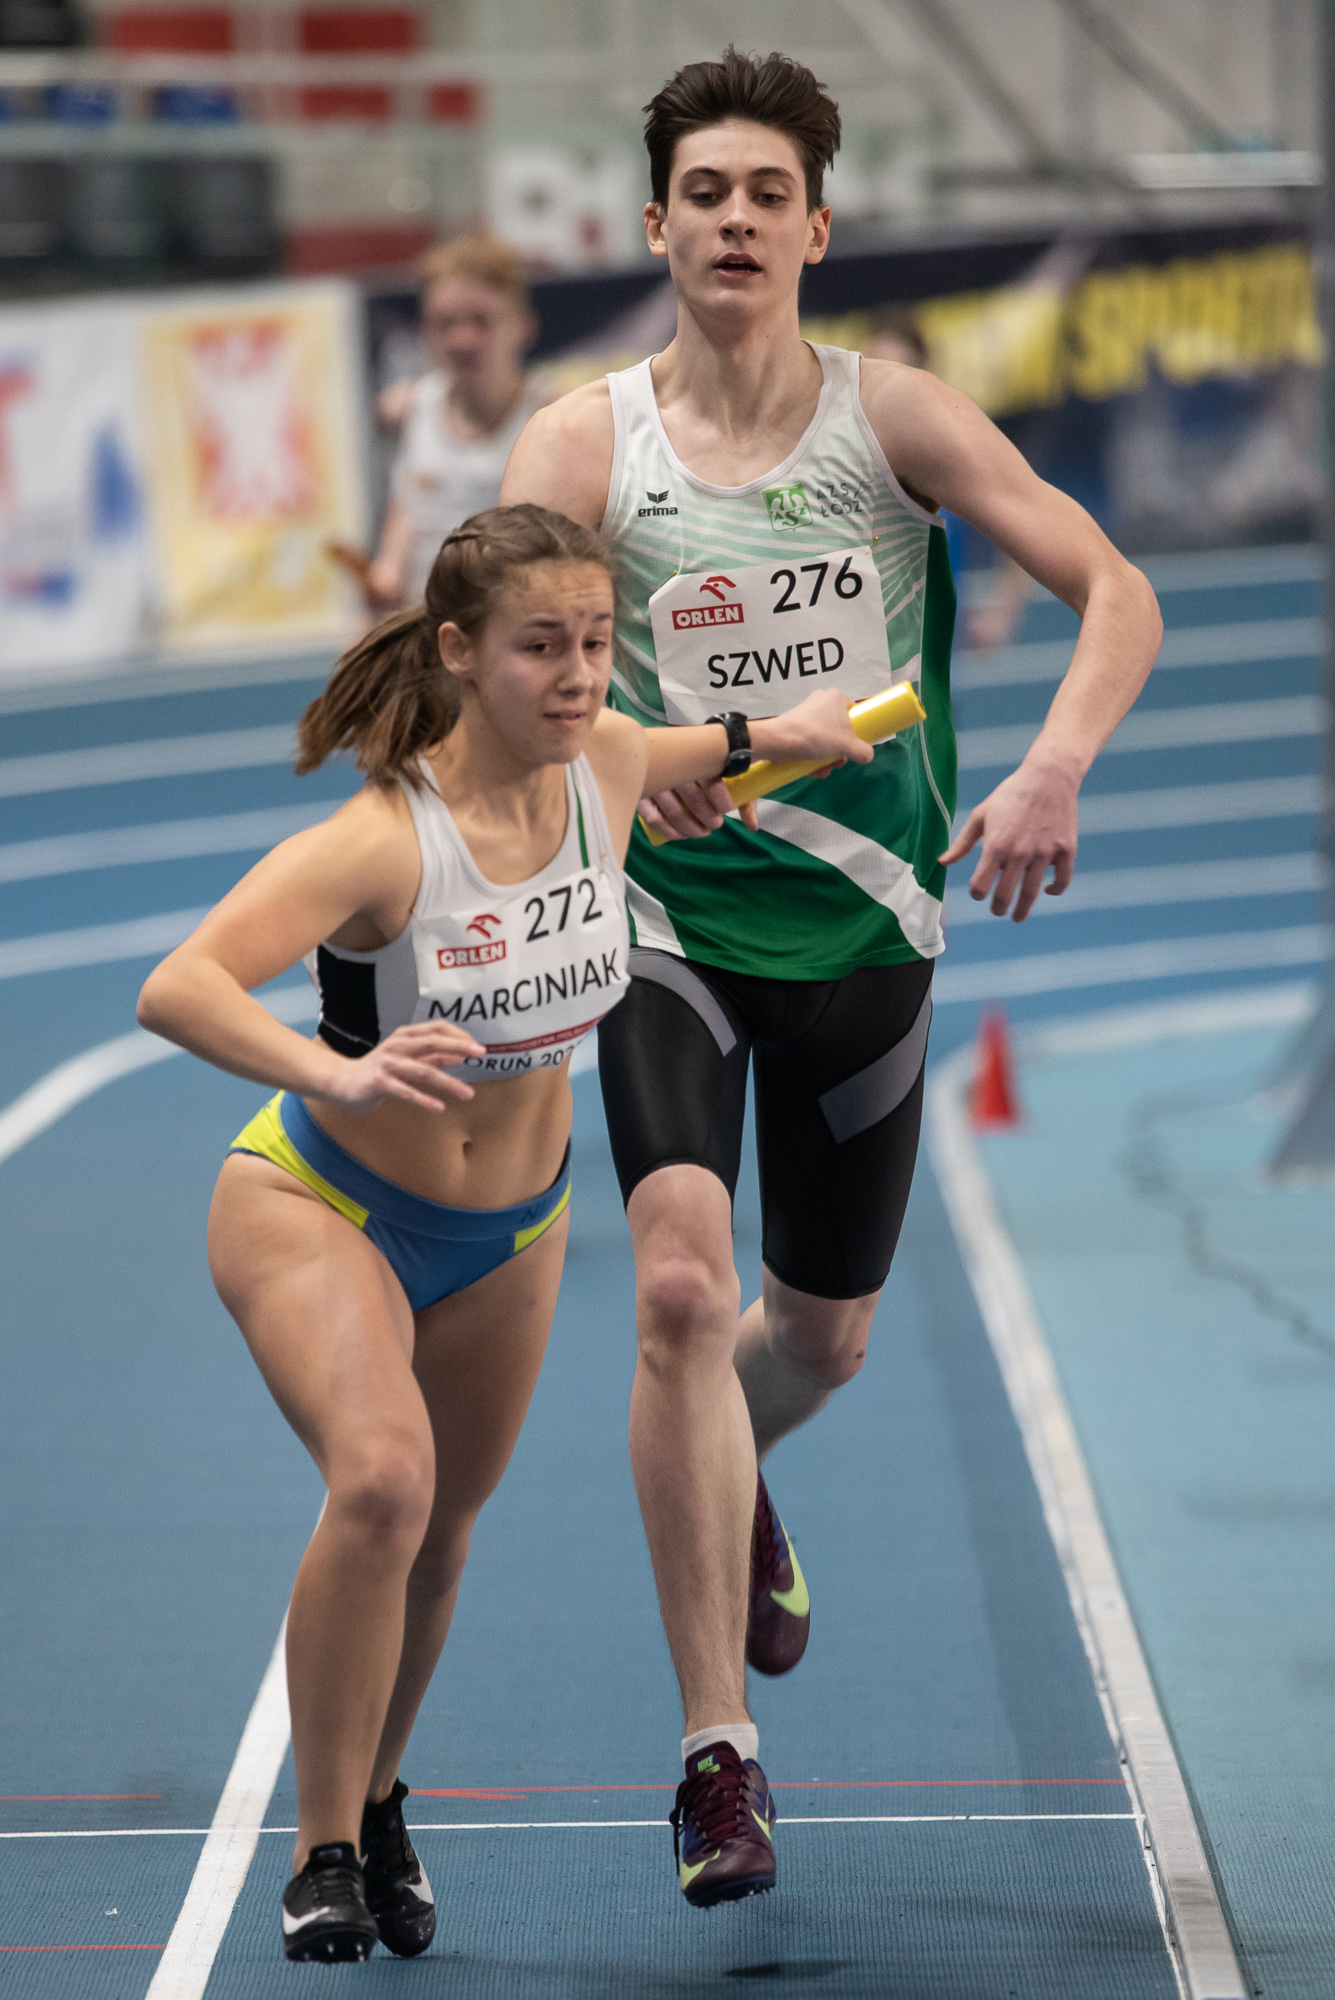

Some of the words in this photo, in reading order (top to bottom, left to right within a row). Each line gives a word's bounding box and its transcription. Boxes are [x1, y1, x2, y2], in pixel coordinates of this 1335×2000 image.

[637, 505, 679, 518] erima
[769, 556, 863, 614] 276
[675, 605, 741, 628] ORLEN
[707, 637, 845, 689] SZWED
[524, 878, 603, 943] 272
[440, 943, 504, 967] ORLEN
[428, 948, 621, 1023] MARCINIAK
[463, 1051, 533, 1072] ORUŃ
